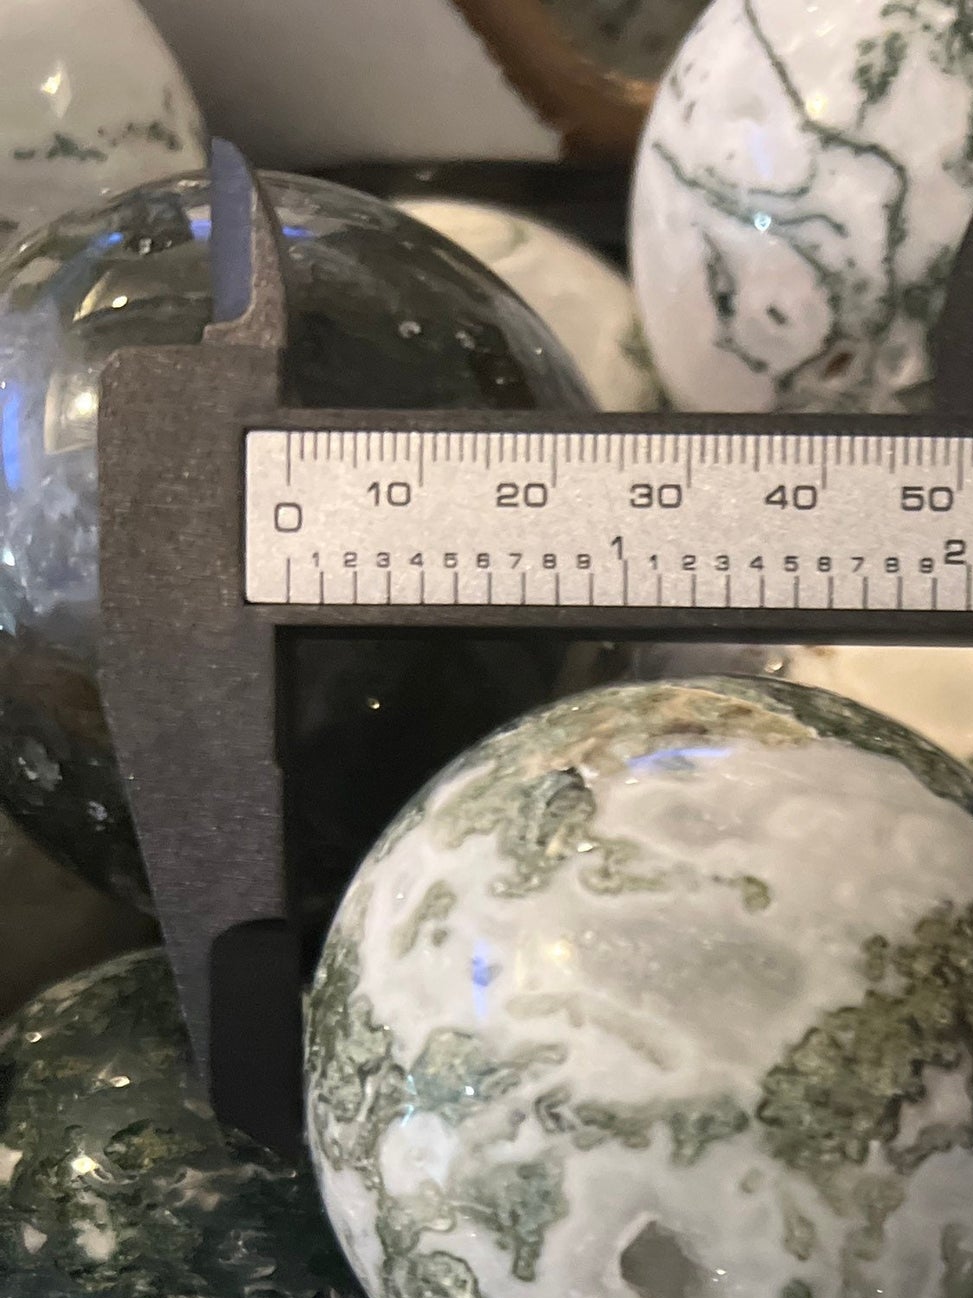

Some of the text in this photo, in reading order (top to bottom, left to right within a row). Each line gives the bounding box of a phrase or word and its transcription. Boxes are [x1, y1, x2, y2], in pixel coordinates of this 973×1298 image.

[273, 501, 304, 534] 0
[366, 480, 412, 507] 10
[495, 481, 549, 509] 20
[628, 482, 683, 510] 30
[763, 484, 819, 511] 40
[899, 485, 955, 513] 50
[311, 550, 320, 568] 1
[342, 550, 358, 569] 2
[375, 551, 391, 569] 3
[408, 551, 425, 568] 4
[442, 551, 459, 569] 5
[475, 551, 491, 570] 6
[508, 551, 524, 570] 7
[541, 552, 558, 570] 8
[575, 553, 592, 570] 9
[610, 535, 623, 561] 1
[648, 553, 659, 571] 1
[681, 553, 697, 572] 2
[714, 554, 731, 572] 3
[748, 555, 766, 572] 4
[783, 554, 800, 573] 5
[849, 556, 866, 573] 7
[883, 556, 901, 574] 8
[918, 557, 936, 575] 9
[943, 538, 967, 565] 2
